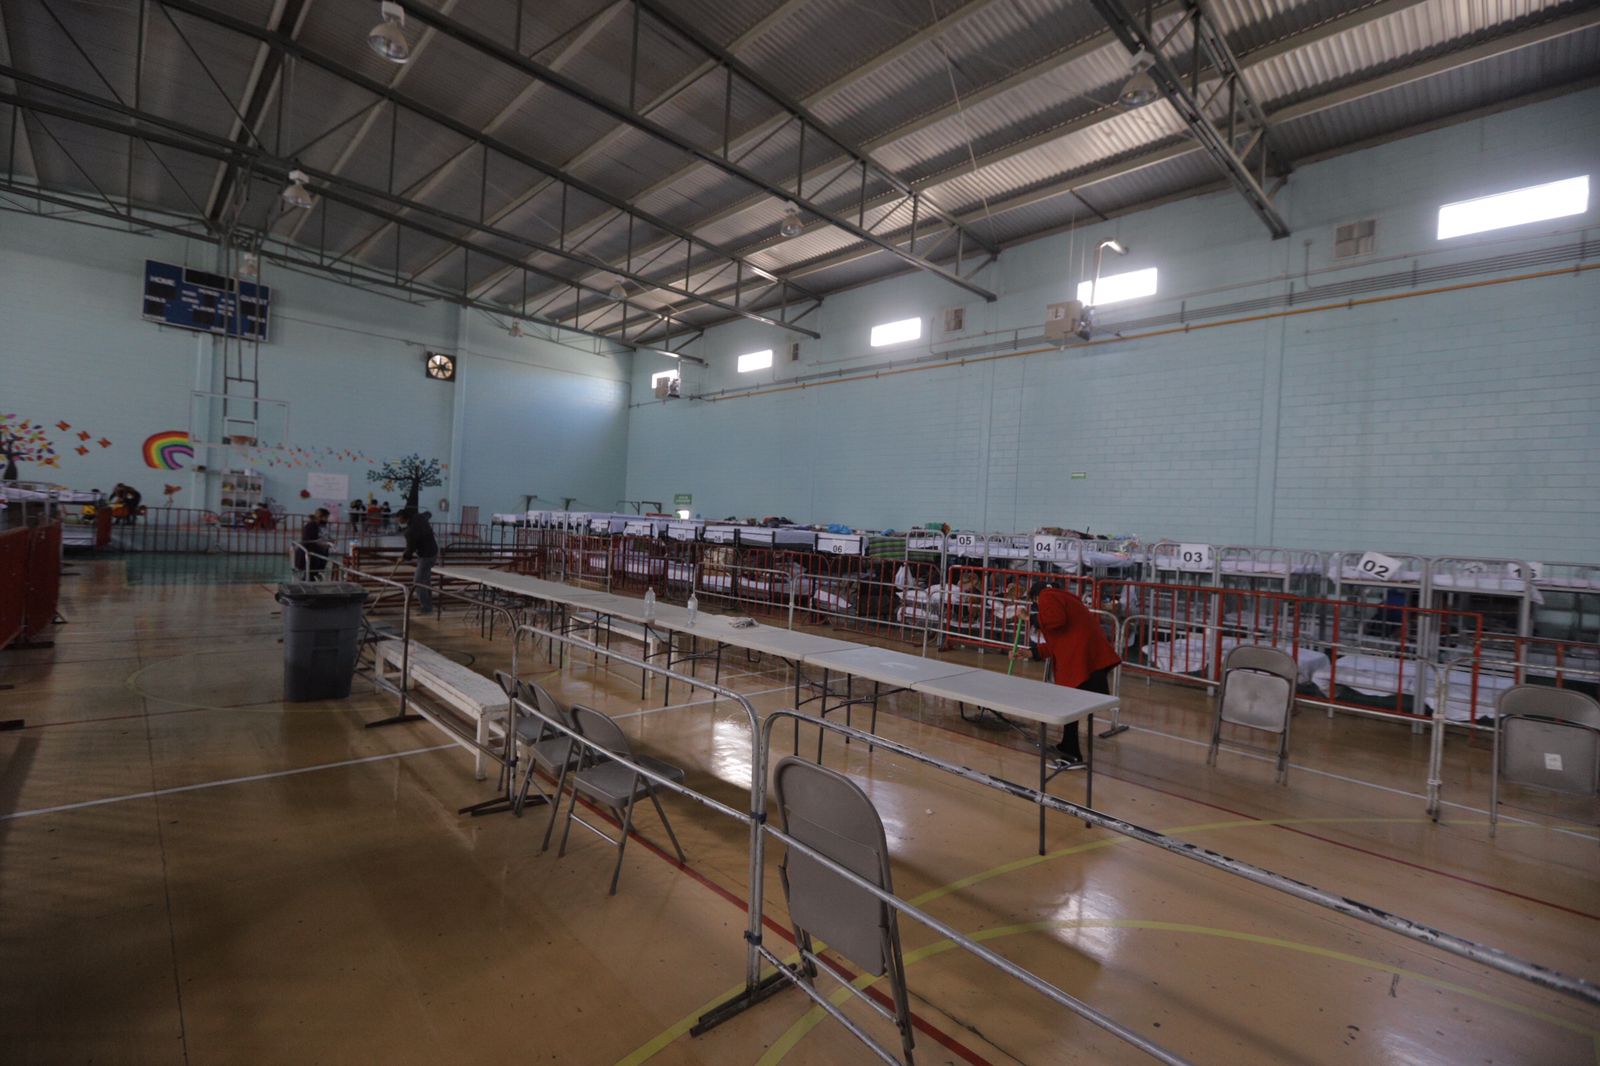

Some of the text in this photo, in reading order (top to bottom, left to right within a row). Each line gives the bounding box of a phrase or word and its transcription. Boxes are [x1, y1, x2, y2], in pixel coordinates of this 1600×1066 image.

[959, 536, 972, 545] 05
[832, 545, 843, 553] 06
[1036, 542, 1051, 552] 04
[1183, 551, 1203, 563] 03
[1363, 560, 1389, 578] 02
